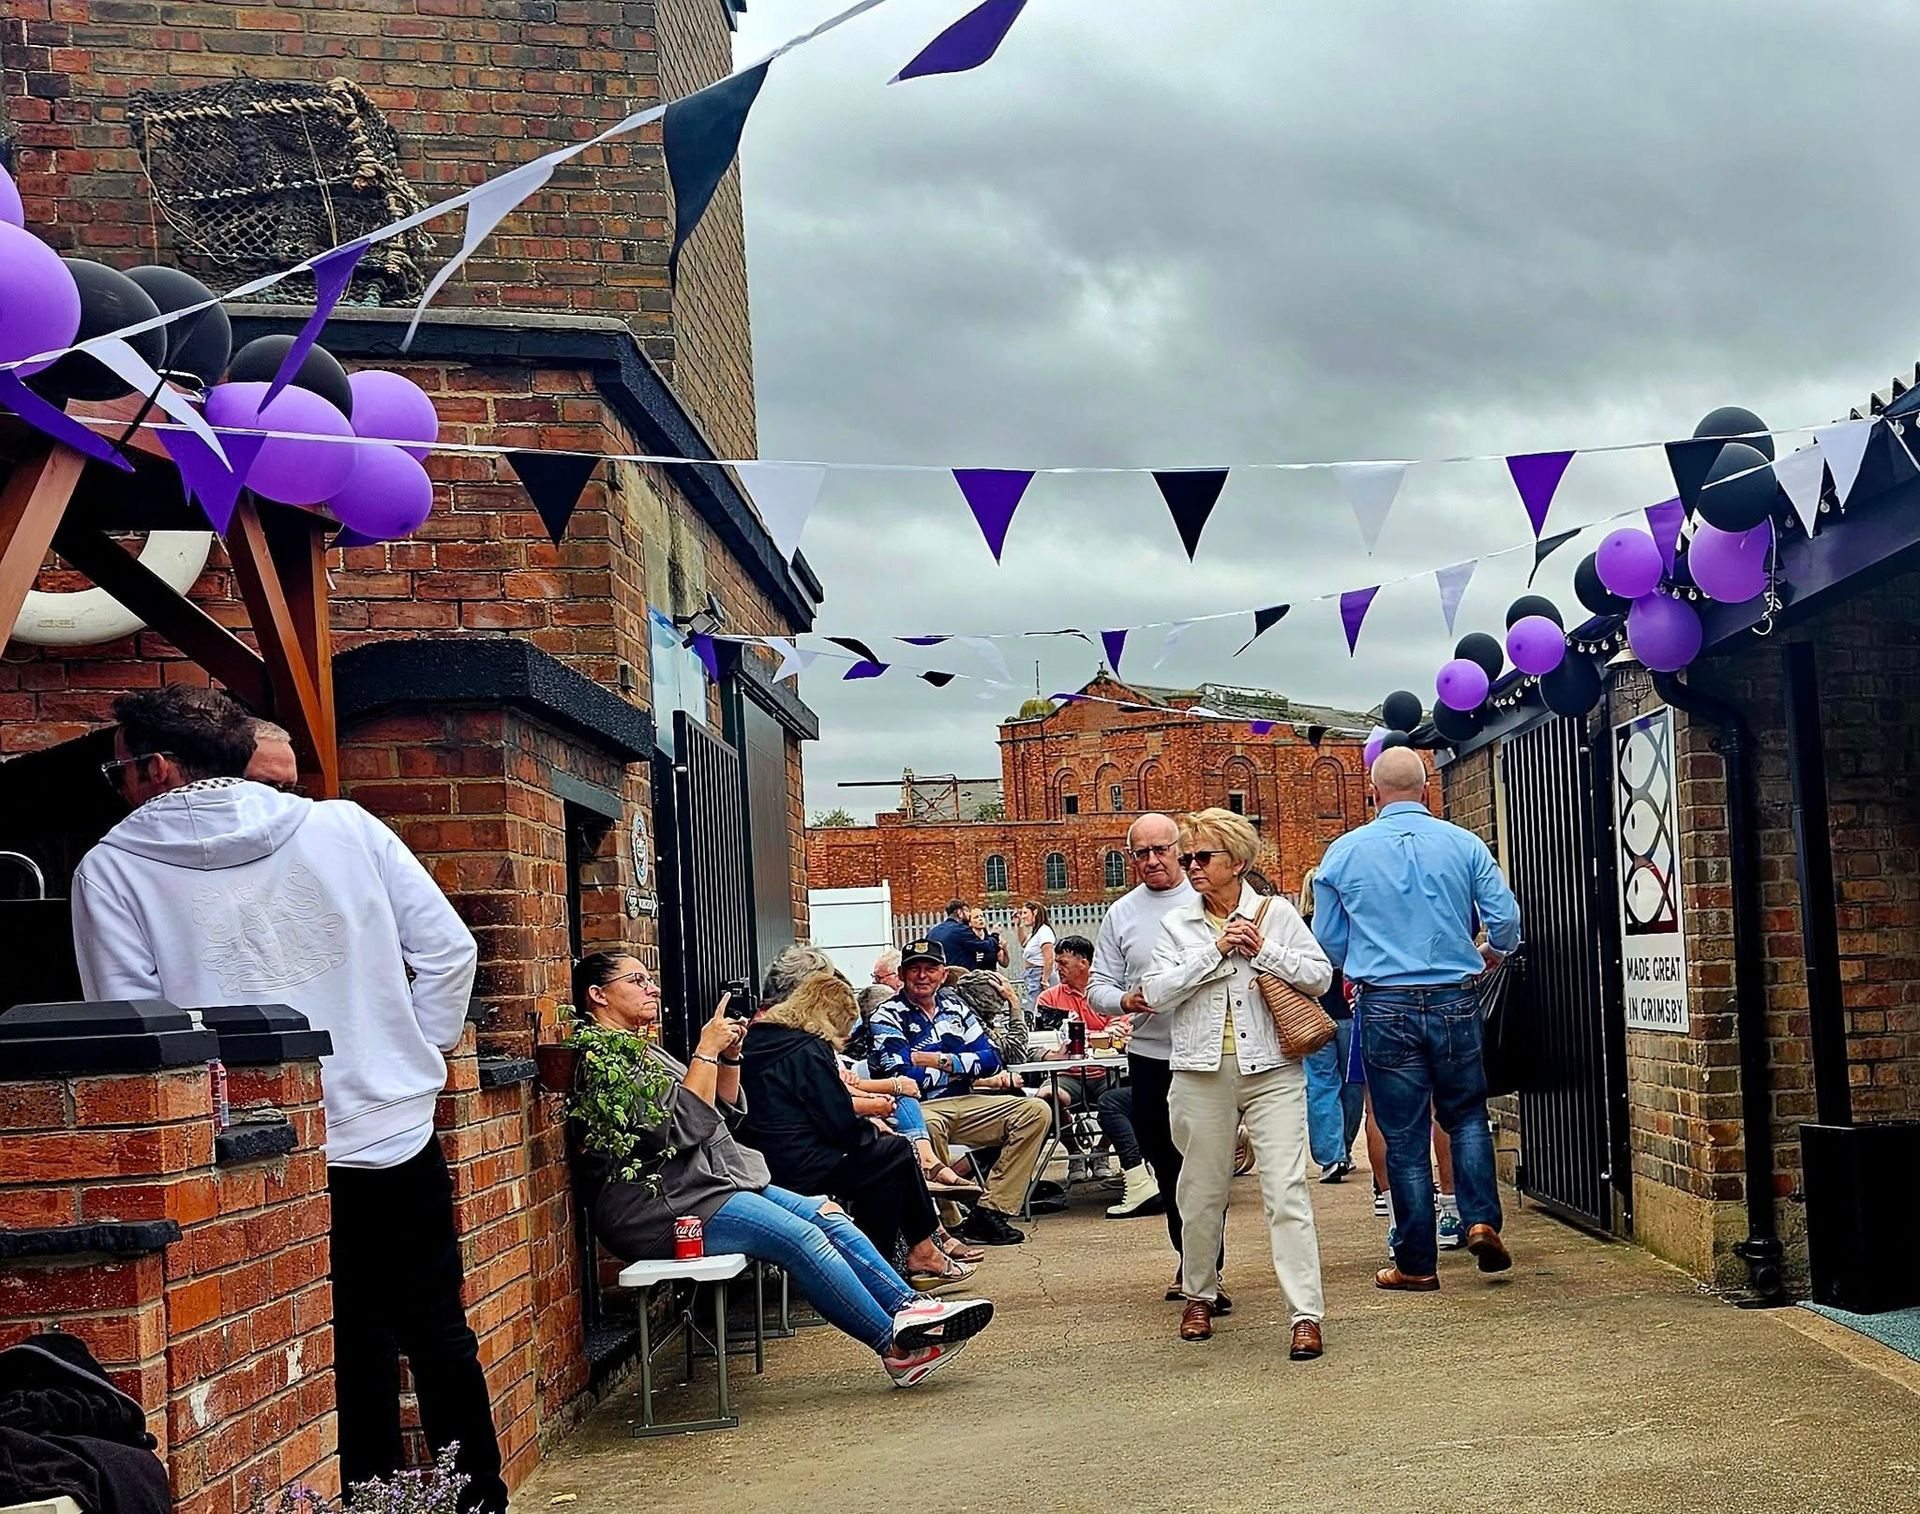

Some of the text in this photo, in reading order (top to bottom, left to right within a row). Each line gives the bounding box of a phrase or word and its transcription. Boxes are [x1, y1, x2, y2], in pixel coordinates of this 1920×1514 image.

[1627, 957, 1681, 981] MADE GREAT
[1629, 997, 1683, 1024] IN GRIMSBY
